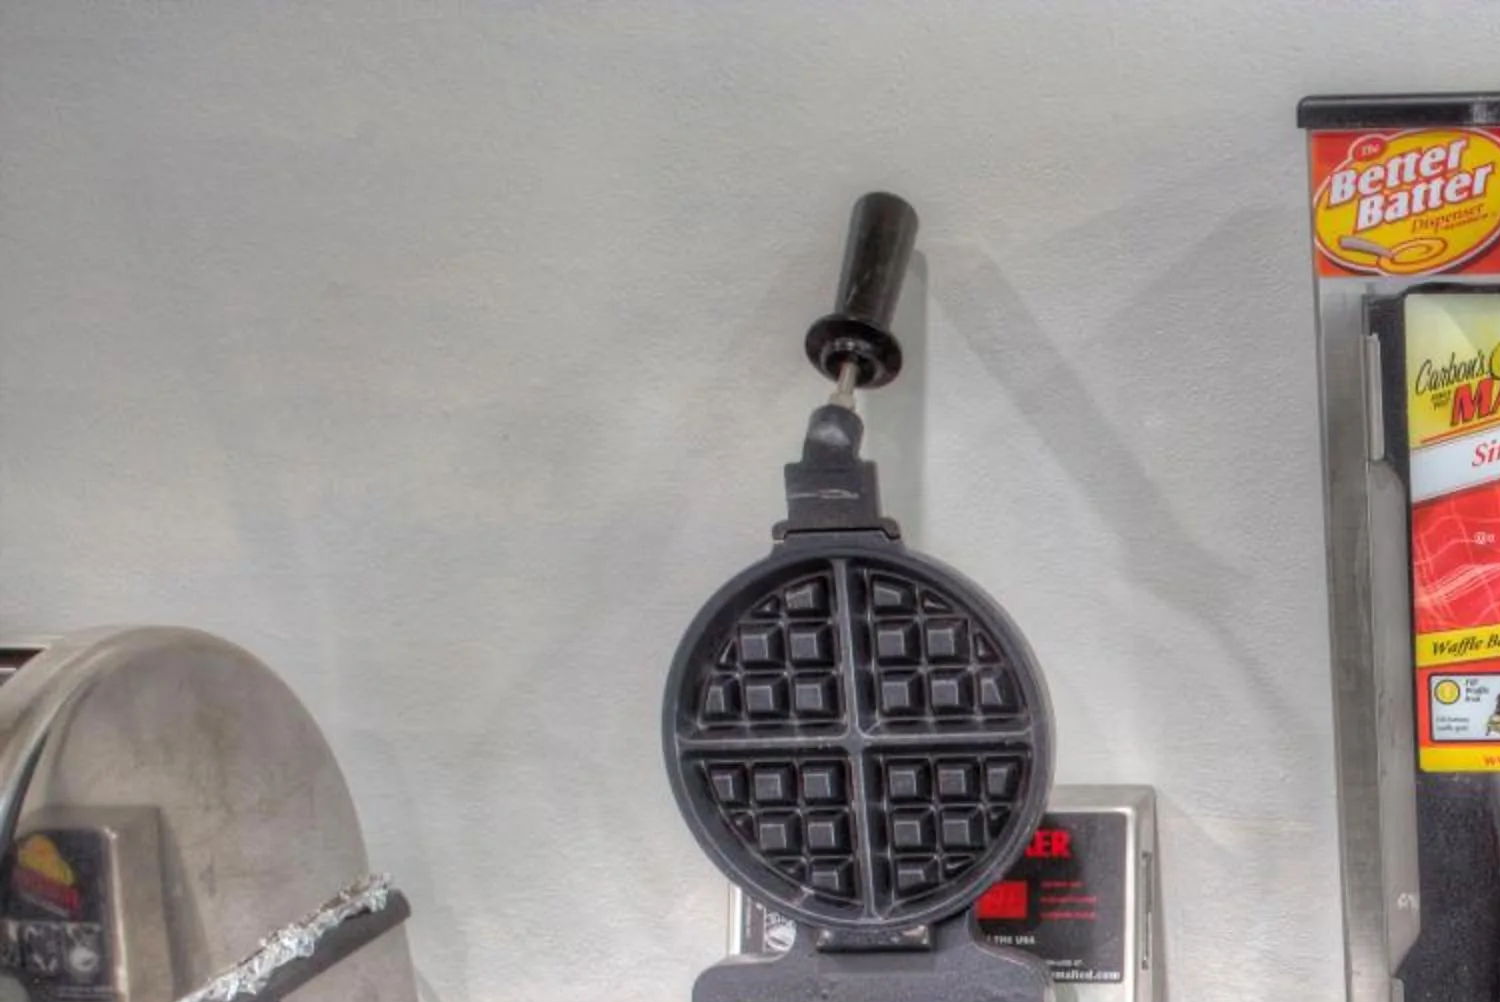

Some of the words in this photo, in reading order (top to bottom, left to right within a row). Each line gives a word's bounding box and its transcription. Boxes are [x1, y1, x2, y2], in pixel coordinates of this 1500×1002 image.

[1328, 138, 1468, 207] Better
[1354, 163, 1494, 234] Batter
[1411, 203, 1485, 233] Dispenser
[1431, 634, 1485, 656] Waffle
